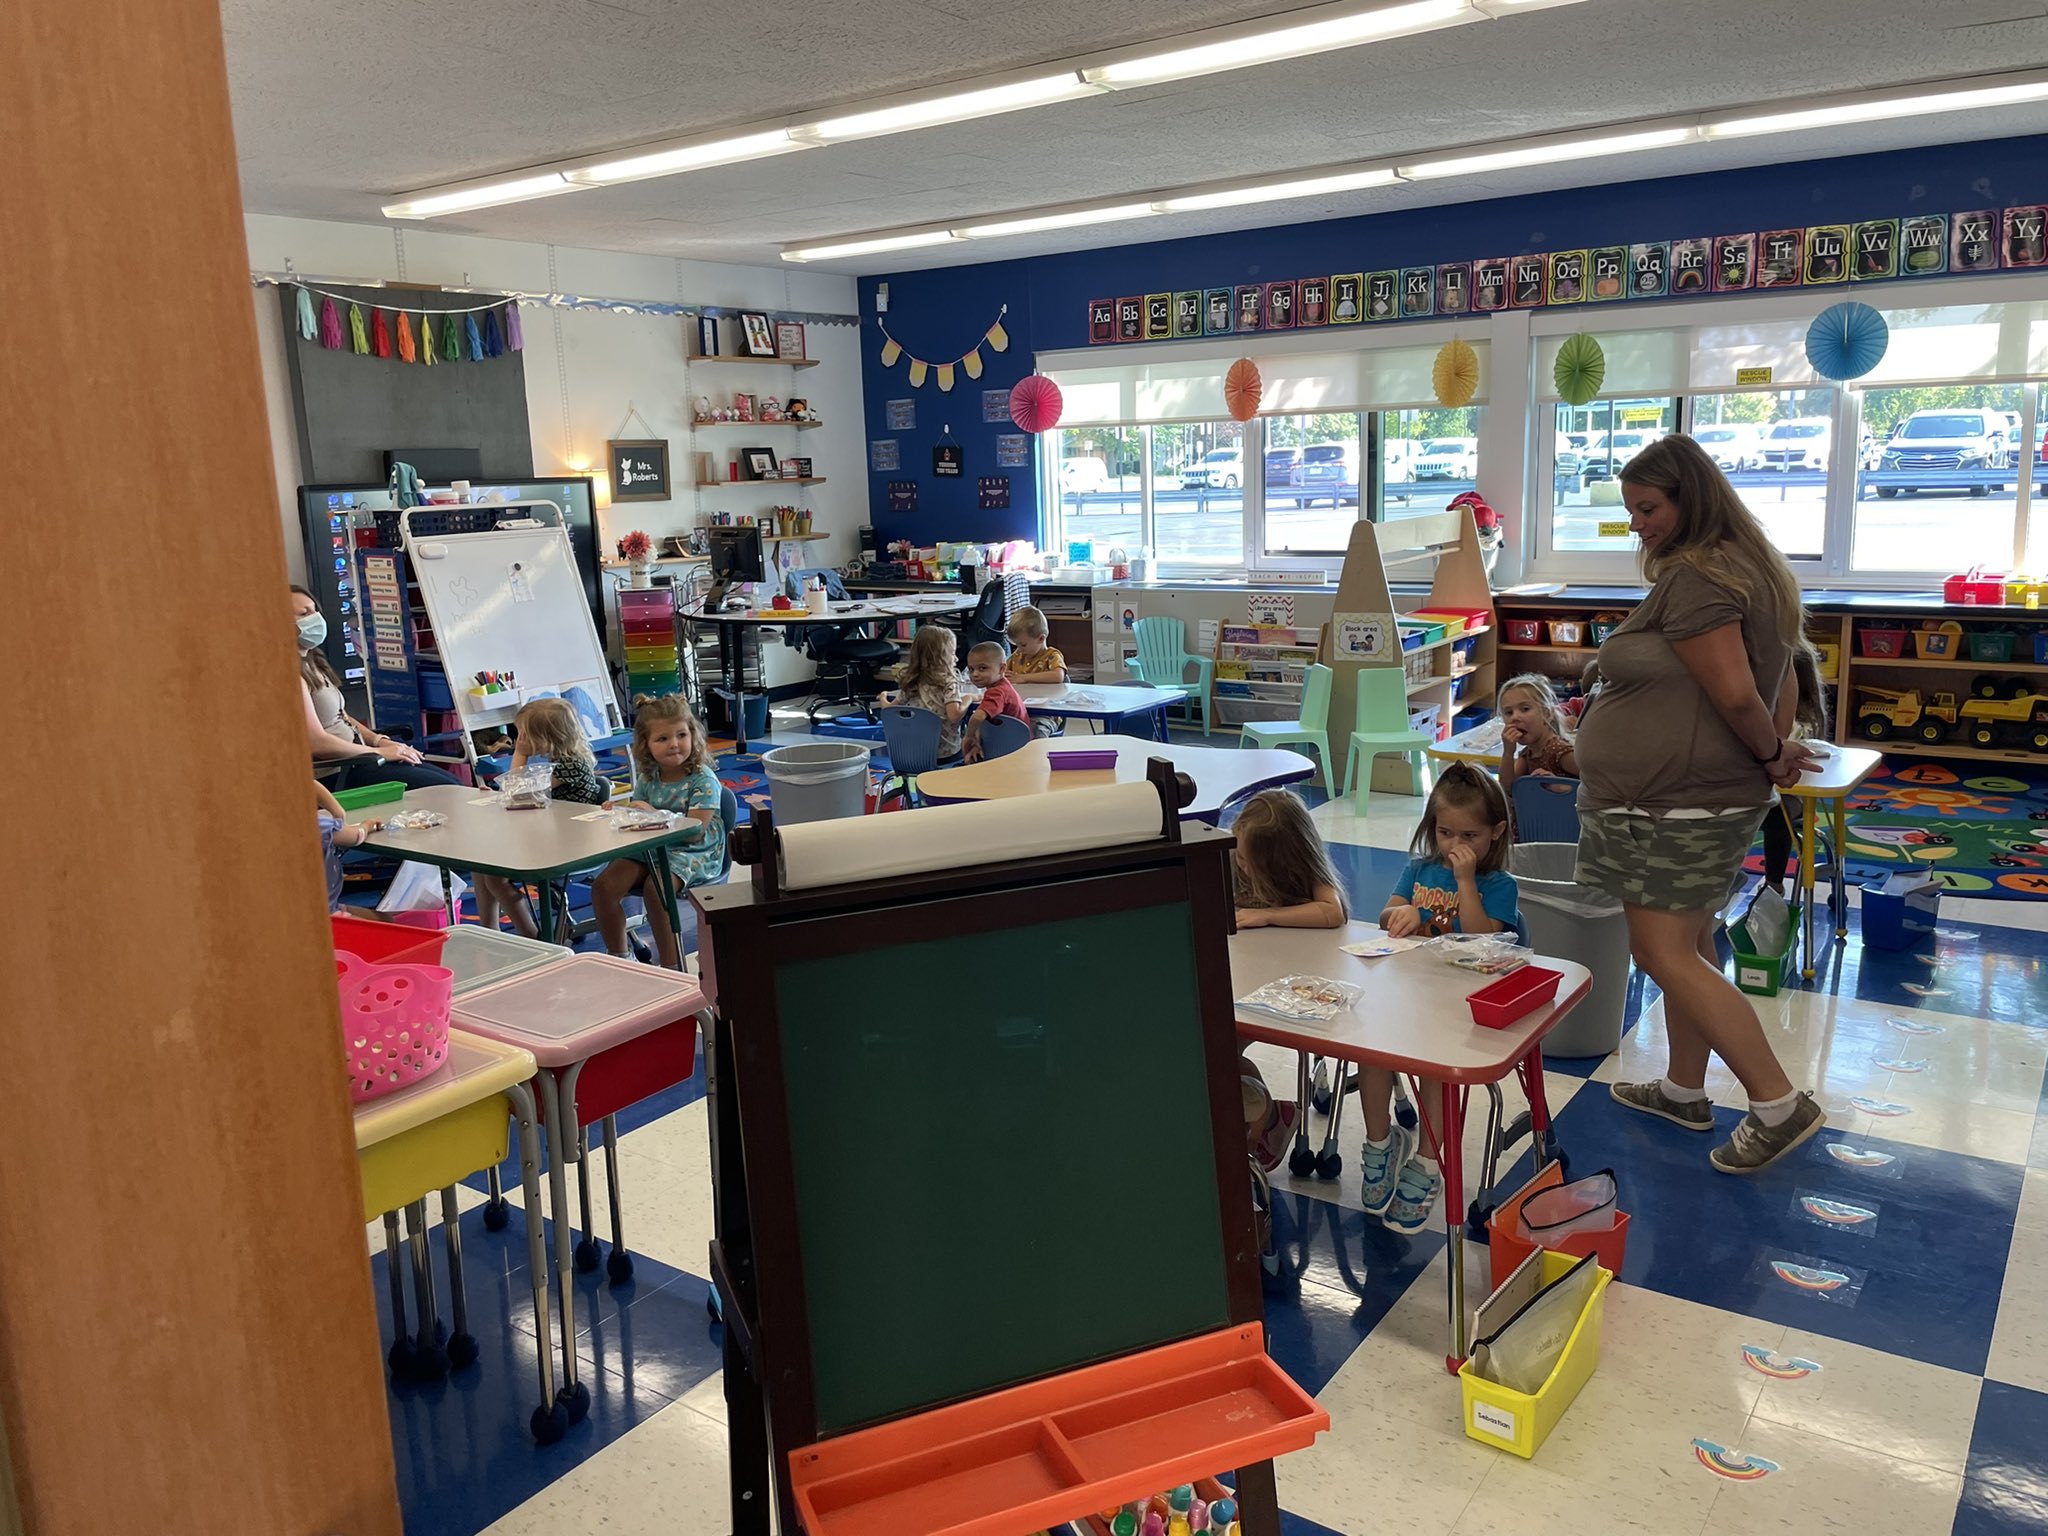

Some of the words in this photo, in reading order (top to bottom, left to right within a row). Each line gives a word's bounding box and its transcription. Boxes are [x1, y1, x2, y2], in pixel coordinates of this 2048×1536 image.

[1910, 229, 1940, 247] Ww
[1963, 223, 1989, 242] Xx
[2015, 219, 2040, 241] Yy
[1770, 241, 1792, 260] Tt
[1815, 238, 1840, 255] Uu
[1862, 233, 1888, 251] Vv
[1637, 254, 1662, 274] Qq
[1680, 251, 1702, 268] Rr
[1723, 247, 1746, 264] Ss
[1519, 265, 1539, 282] Nn
[1557, 263, 1579, 278] Oo
[1597, 258, 1618, 278] Pp
[1408, 277, 1427, 293] Kk
[1446, 273, 1461, 289] Ll
[1480, 269, 1503, 286] Mm
[1305, 287, 1323, 303] Hh
[1341, 284, 1353, 300] Ii
[1374, 281, 1389, 300] Jj
[1180, 300, 1197, 315] Dd
[1210, 297, 1227, 312] Ee
[1242, 294, 1258, 309] Ff
[1272, 292, 1290, 309] Gg
[1094, 310, 1111, 322] Aa
[1122, 305, 1139, 321] Bb
[1150, 303, 1167, 318] Cc
[637, 461, 652, 470] Mrs.
[632, 472, 658, 481] Roberts
[1478, 1411, 1511, 1430] Sebastian
